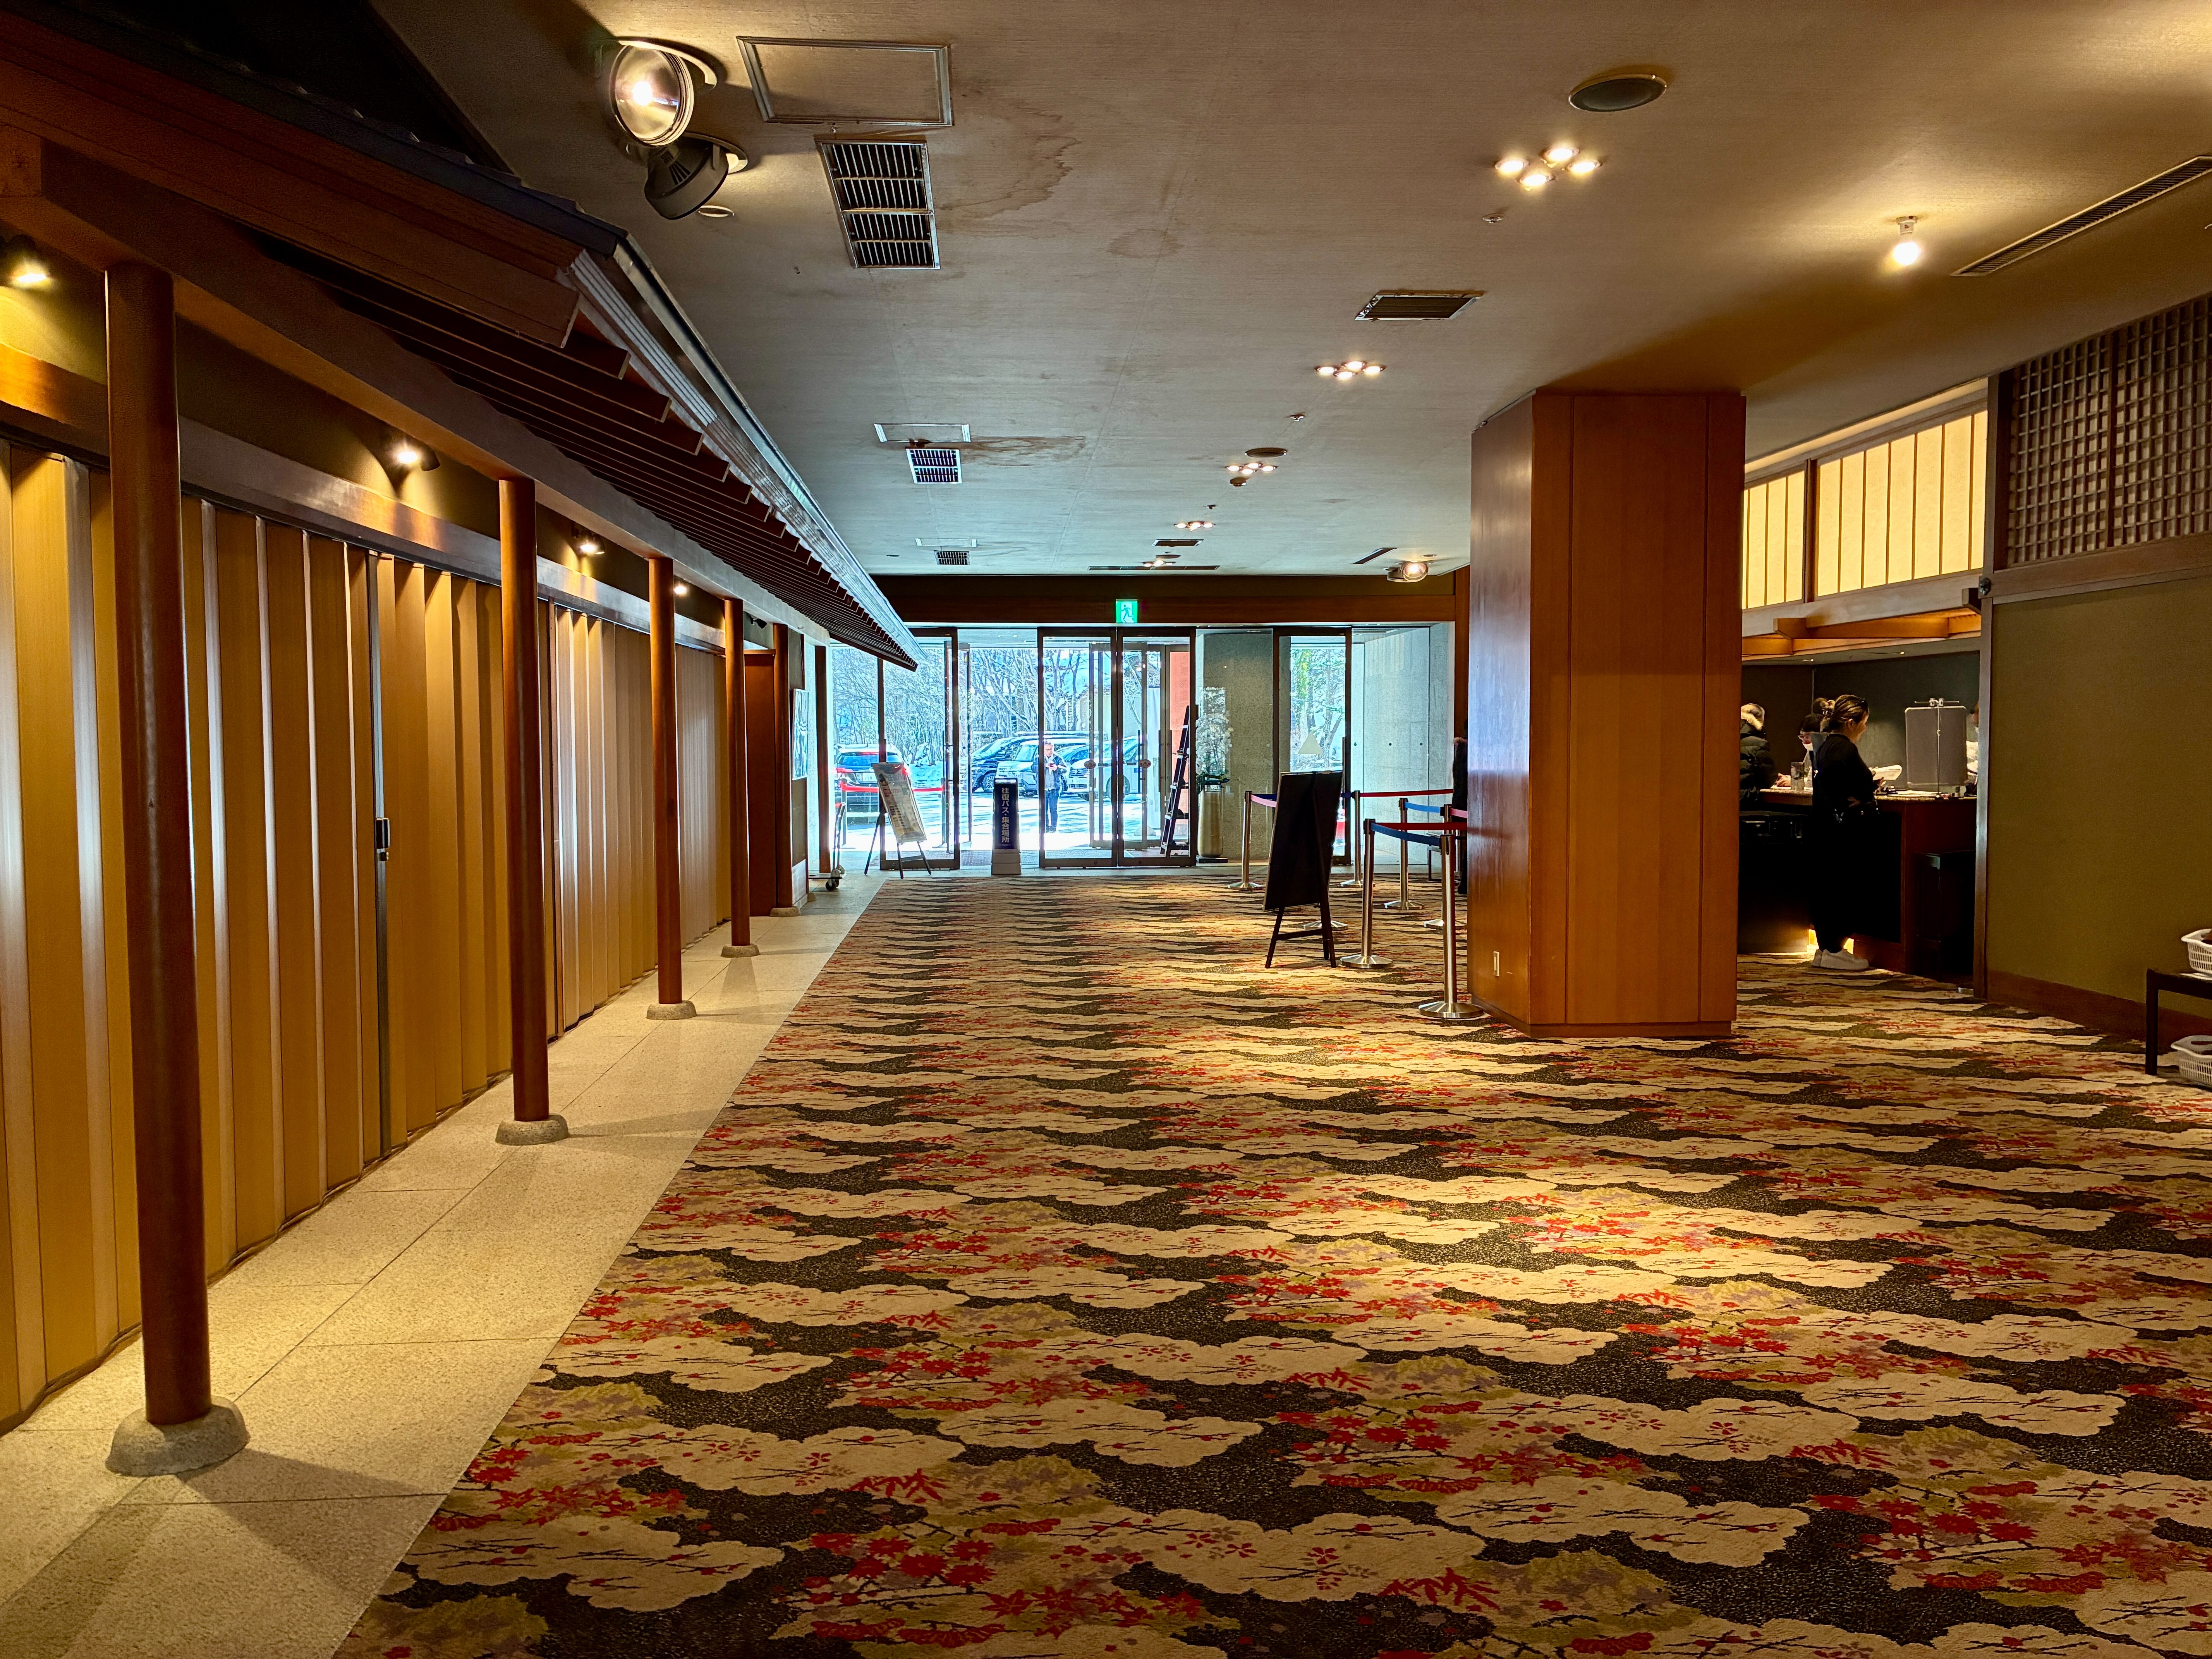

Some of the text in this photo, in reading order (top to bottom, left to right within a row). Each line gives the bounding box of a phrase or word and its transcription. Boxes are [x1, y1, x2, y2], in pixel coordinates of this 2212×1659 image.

[1001, 787, 1010, 843] 往復バス・集合場所
